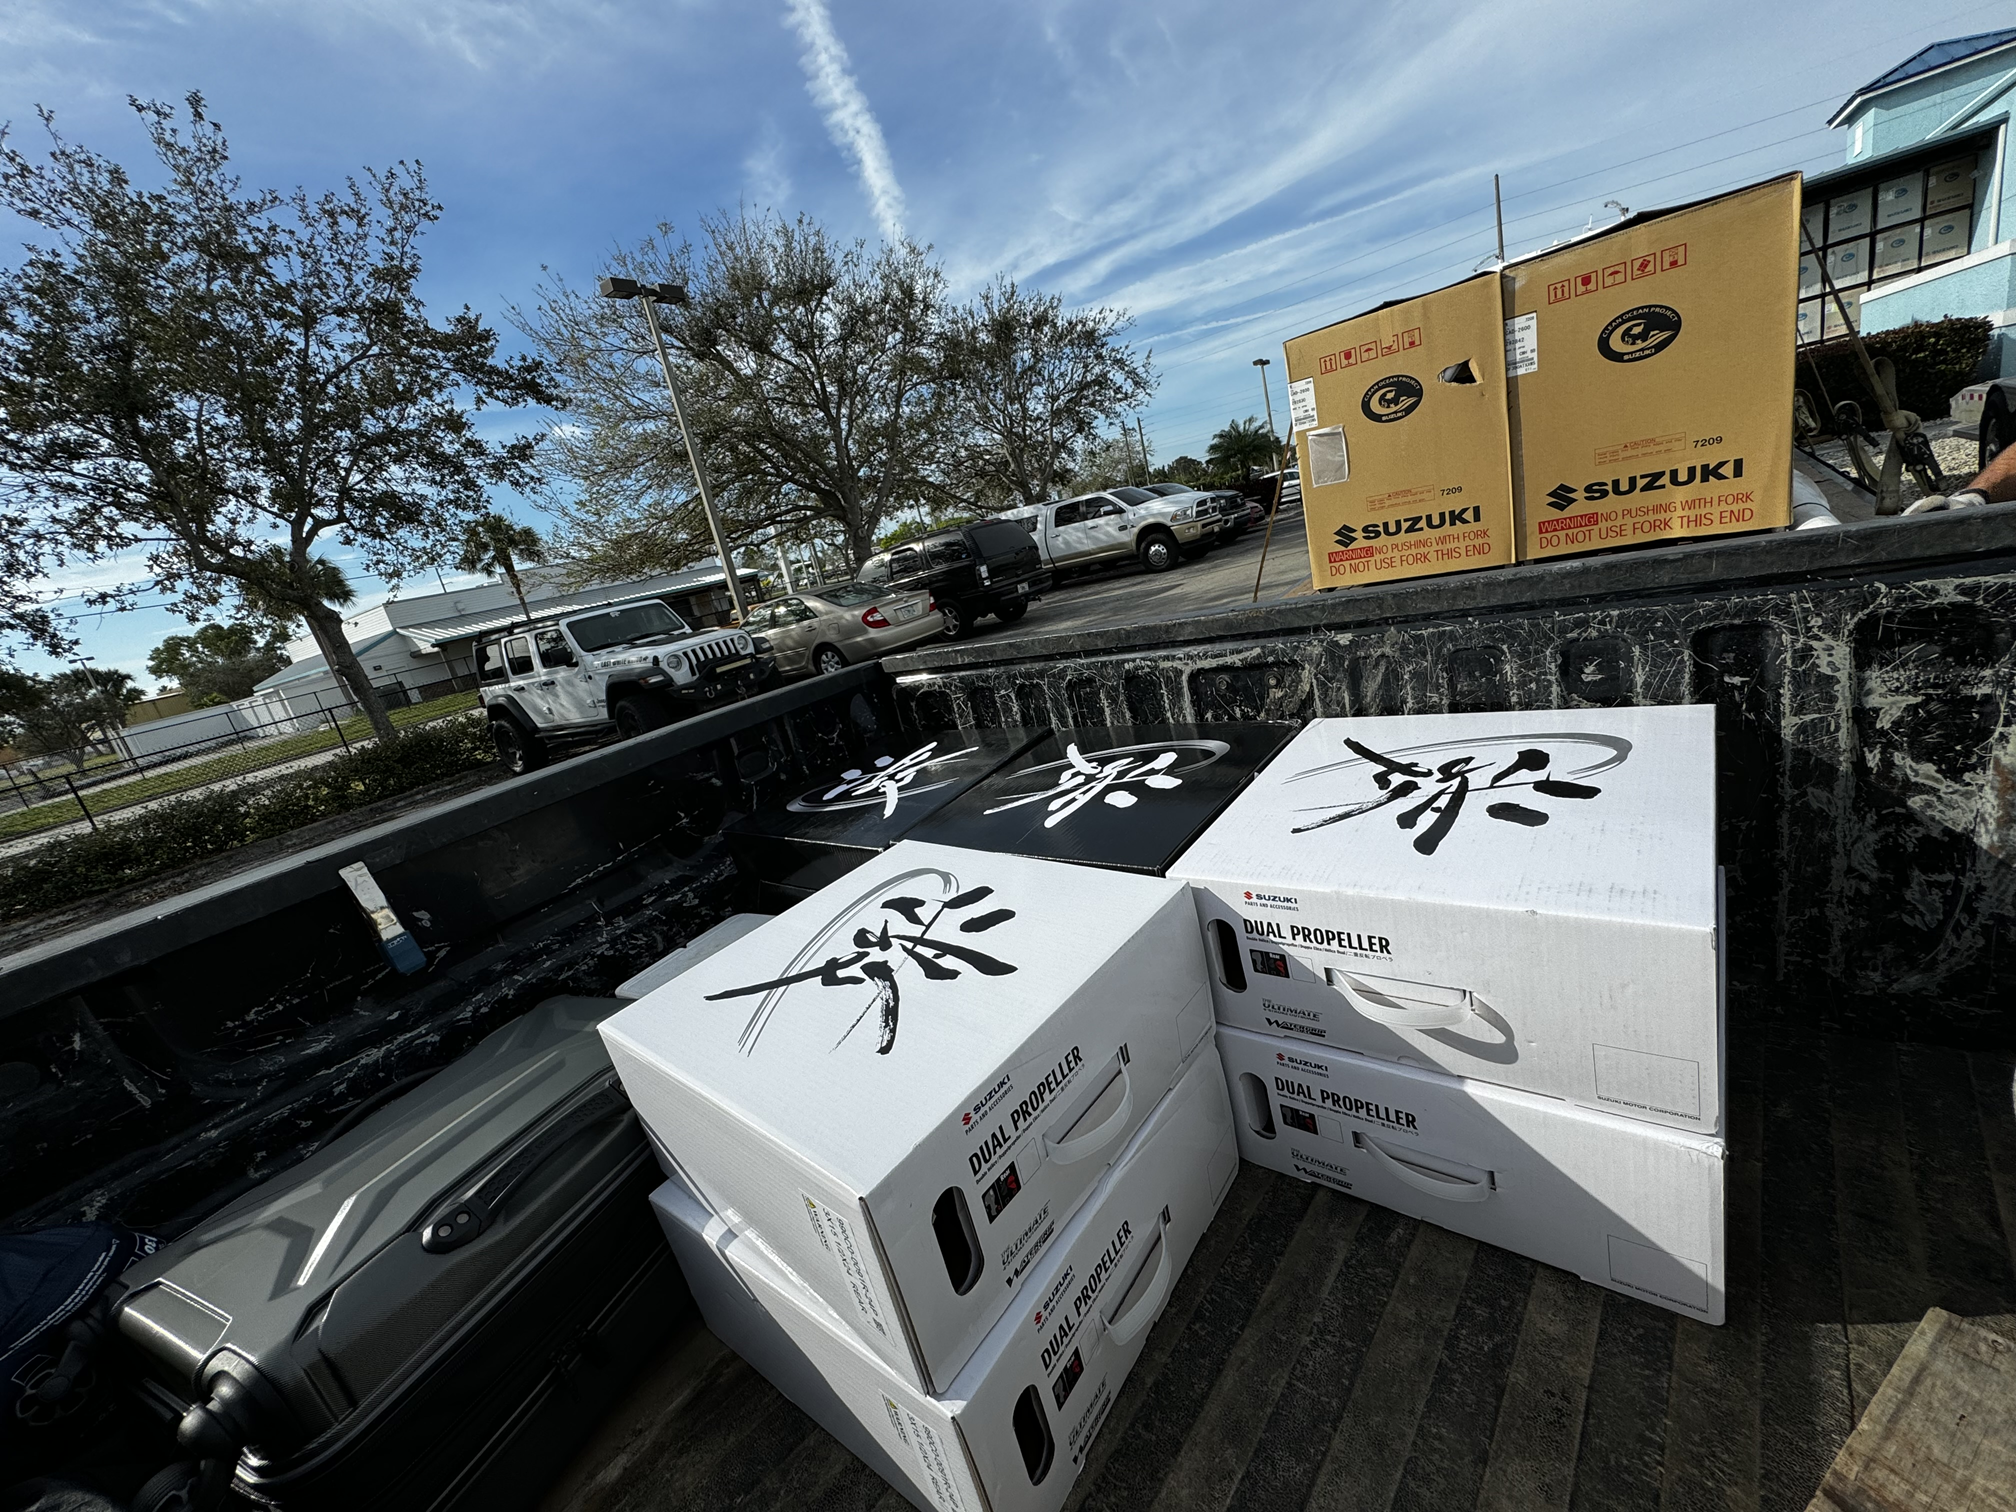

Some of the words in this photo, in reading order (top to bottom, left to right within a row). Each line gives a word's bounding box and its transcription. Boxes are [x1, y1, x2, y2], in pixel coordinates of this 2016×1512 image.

[1603, 317, 1622, 338] CLEAN
[1622, 308, 1649, 320] OCEAN
[1650, 307, 1678, 322] PROJECT
[1623, 348, 1655, 361] SUZUKI
[1364, 385, 1378, 402] CLEAN
[1378, 378, 1398, 388] OCEAN
[1399, 376, 1420, 390] PROJECT
[1382, 410, 1406, 421] SUZUKI
[1629, 438, 1656, 448] CAUTION
[1692, 436, 1723, 448] 7209
[1440, 486, 1462, 496] 7209
[1583, 458, 1744, 502] SUZUKI
[1361, 505, 1482, 541] SUZUKI
[1539, 534, 1561, 550] DO
[1565, 529, 1594, 546] NOT
[1598, 524, 1628, 540] USE
[1632, 517, 1674, 536] FORK
[1677, 512, 1714, 530] THIS
[1718, 508, 1754, 525] END
[1540, 514, 1598, 534] WARNING!
[1600, 510, 1618, 522] NO
[1621, 501, 1677, 520] PUSHING
[1680, 496, 1714, 511] WITH
[1717, 491, 1755, 507] FORK
[1329, 564, 1346, 576] DO
[1349, 560, 1372, 574] NOT
[1374, 556, 1397, 570] USE
[1400, 551, 1432, 567] FORK
[1434, 547, 1462, 562] THIS
[1465, 542, 1492, 557] END
[1330, 546, 1373, 562] WARNING!
[1375, 544, 1389, 556] NO
[1391, 538, 1432, 552] PUSHING
[1434, 532, 1460, 546] WITH
[1462, 528, 1491, 542] FORK
[1254, 893, 1298, 904] SUZUKI
[1270, 904, 1299, 912] ACCESSORIES
[1242, 918, 1287, 939] DUAL
[1290, 924, 1392, 955] PROPELLER
[1276, 1060, 1290, 1069] PARTS
[1290, 1064, 1300, 1072] AND
[1301, 1067, 1330, 1078] ACCESSORIES
[1287, 1056, 1329, 1072] SUZUKI
[965, 1119, 979, 1136] PARTS
[980, 1110, 988, 1122] AND
[988, 1084, 1014, 1112] ACCESSORIES
[968, 1124, 1011, 1177] DUAL
[1010, 1046, 1082, 1132] PROPELLER
[973, 1074, 1010, 1114] SUZUKI
[1274, 1076, 1317, 1102] DUAL
[1320, 1088, 1419, 1130] PROPELLER
[1597, 1096, 1621, 1104] SUZUKI
[1622, 1101, 1647, 1110] MOTOR
[1648, 1106, 1700, 1121] CORPORATION
[812, 1210, 831, 1252] WARNING
[823, 1208, 838, 1239] 3X15
[850, 1280, 868, 1315] REAR
[1037, 1317, 1049, 1334] PARTS
[1048, 1304, 1056, 1318] AND
[1056, 1274, 1076, 1306] ACCESSORIES
[1040, 1314, 1075, 1372] DUAL
[1073, 1220, 1132, 1318] PROPELLER
[1042, 1264, 1074, 1312] SUZUKI
